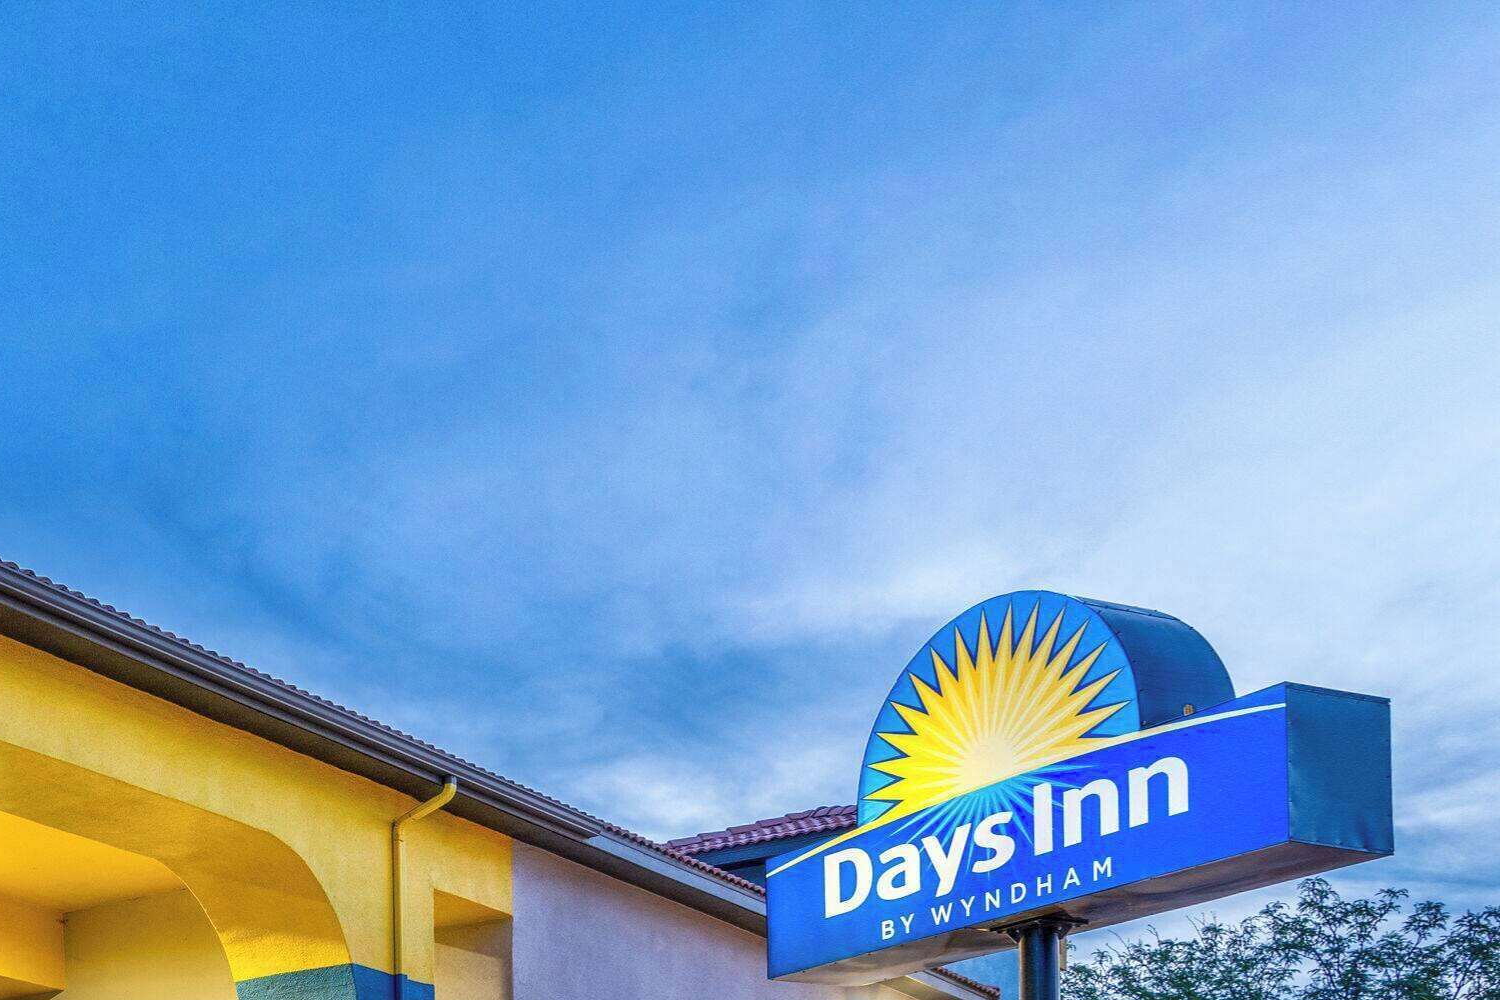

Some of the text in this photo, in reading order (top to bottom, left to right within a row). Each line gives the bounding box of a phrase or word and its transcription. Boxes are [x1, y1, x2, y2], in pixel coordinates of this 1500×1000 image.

[823, 756, 1189, 919] Days Inn
[881, 856, 1113, 940] BY WYNDHAM
